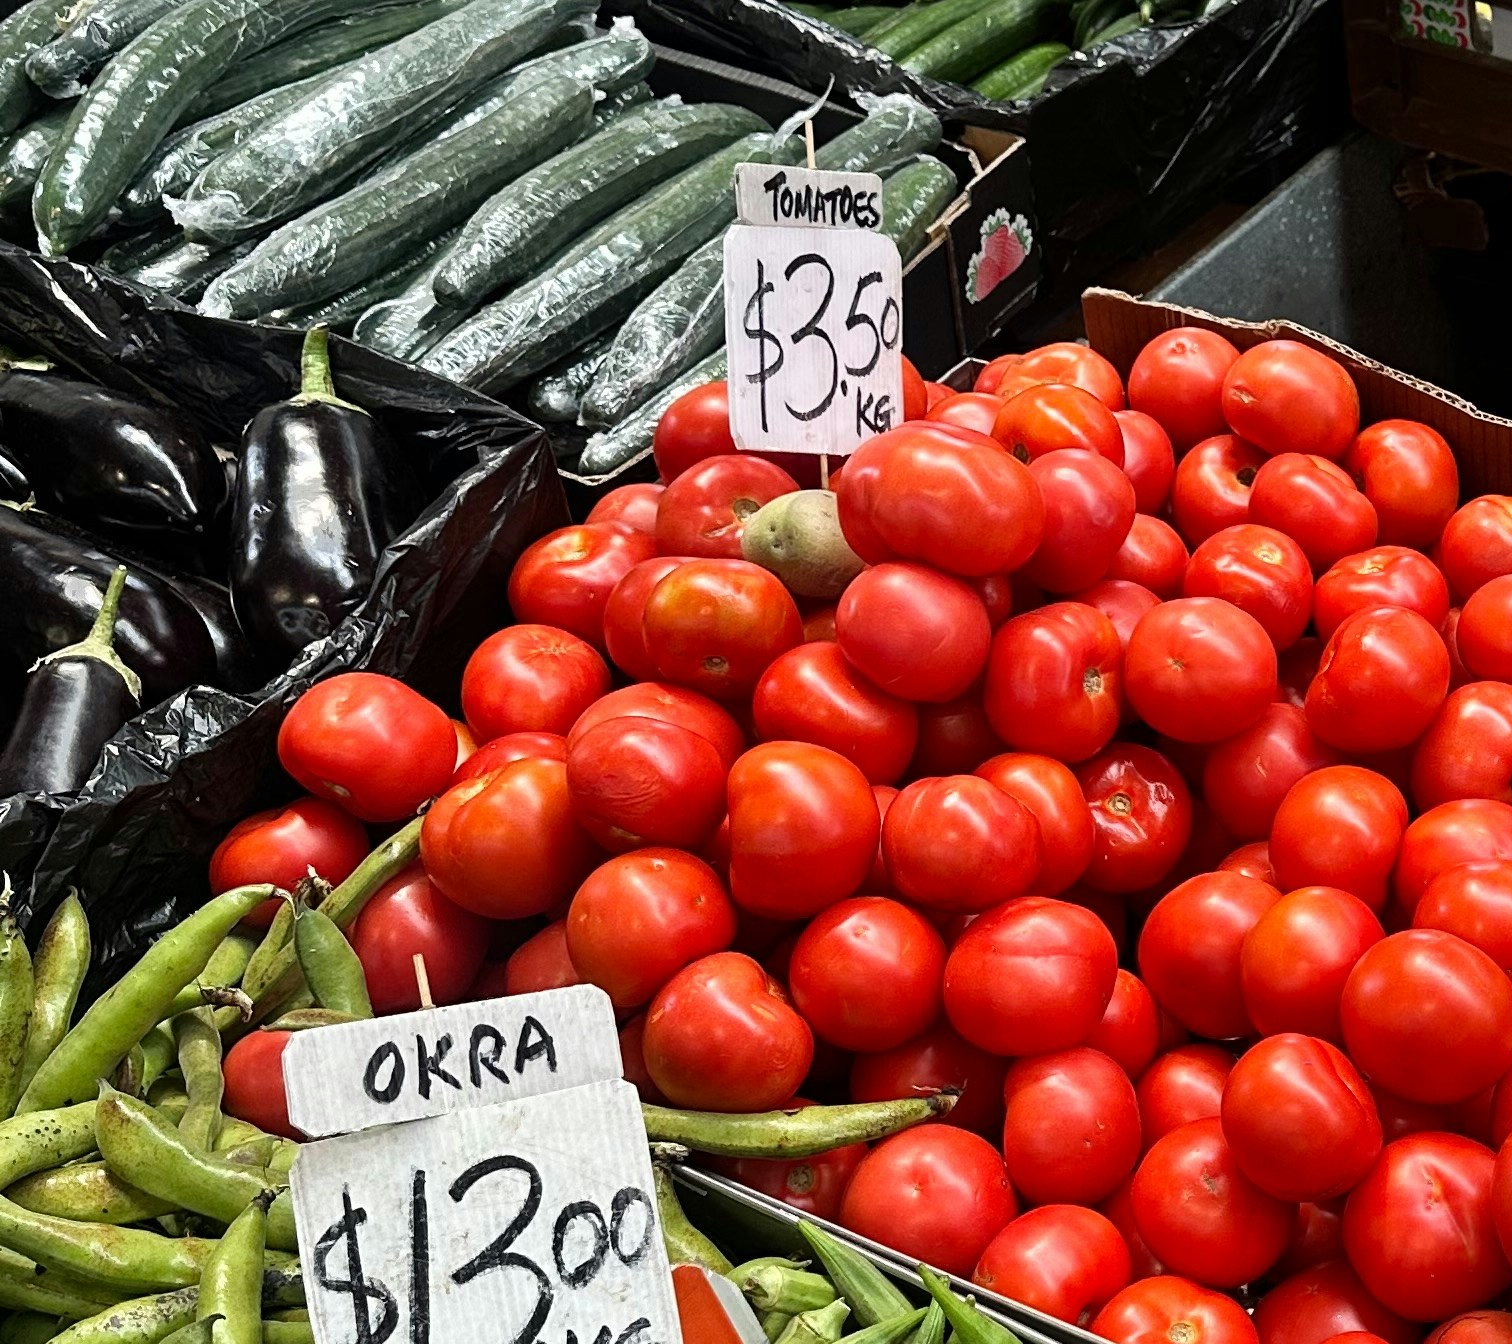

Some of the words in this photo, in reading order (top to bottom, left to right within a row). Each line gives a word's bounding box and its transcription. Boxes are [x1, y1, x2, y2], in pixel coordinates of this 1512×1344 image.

[764, 171, 881, 229] TOMATOES
[743, 253, 900, 433] $3.50
[856, 387, 896, 438] KG
[363, 1015, 558, 1103] OKRA
